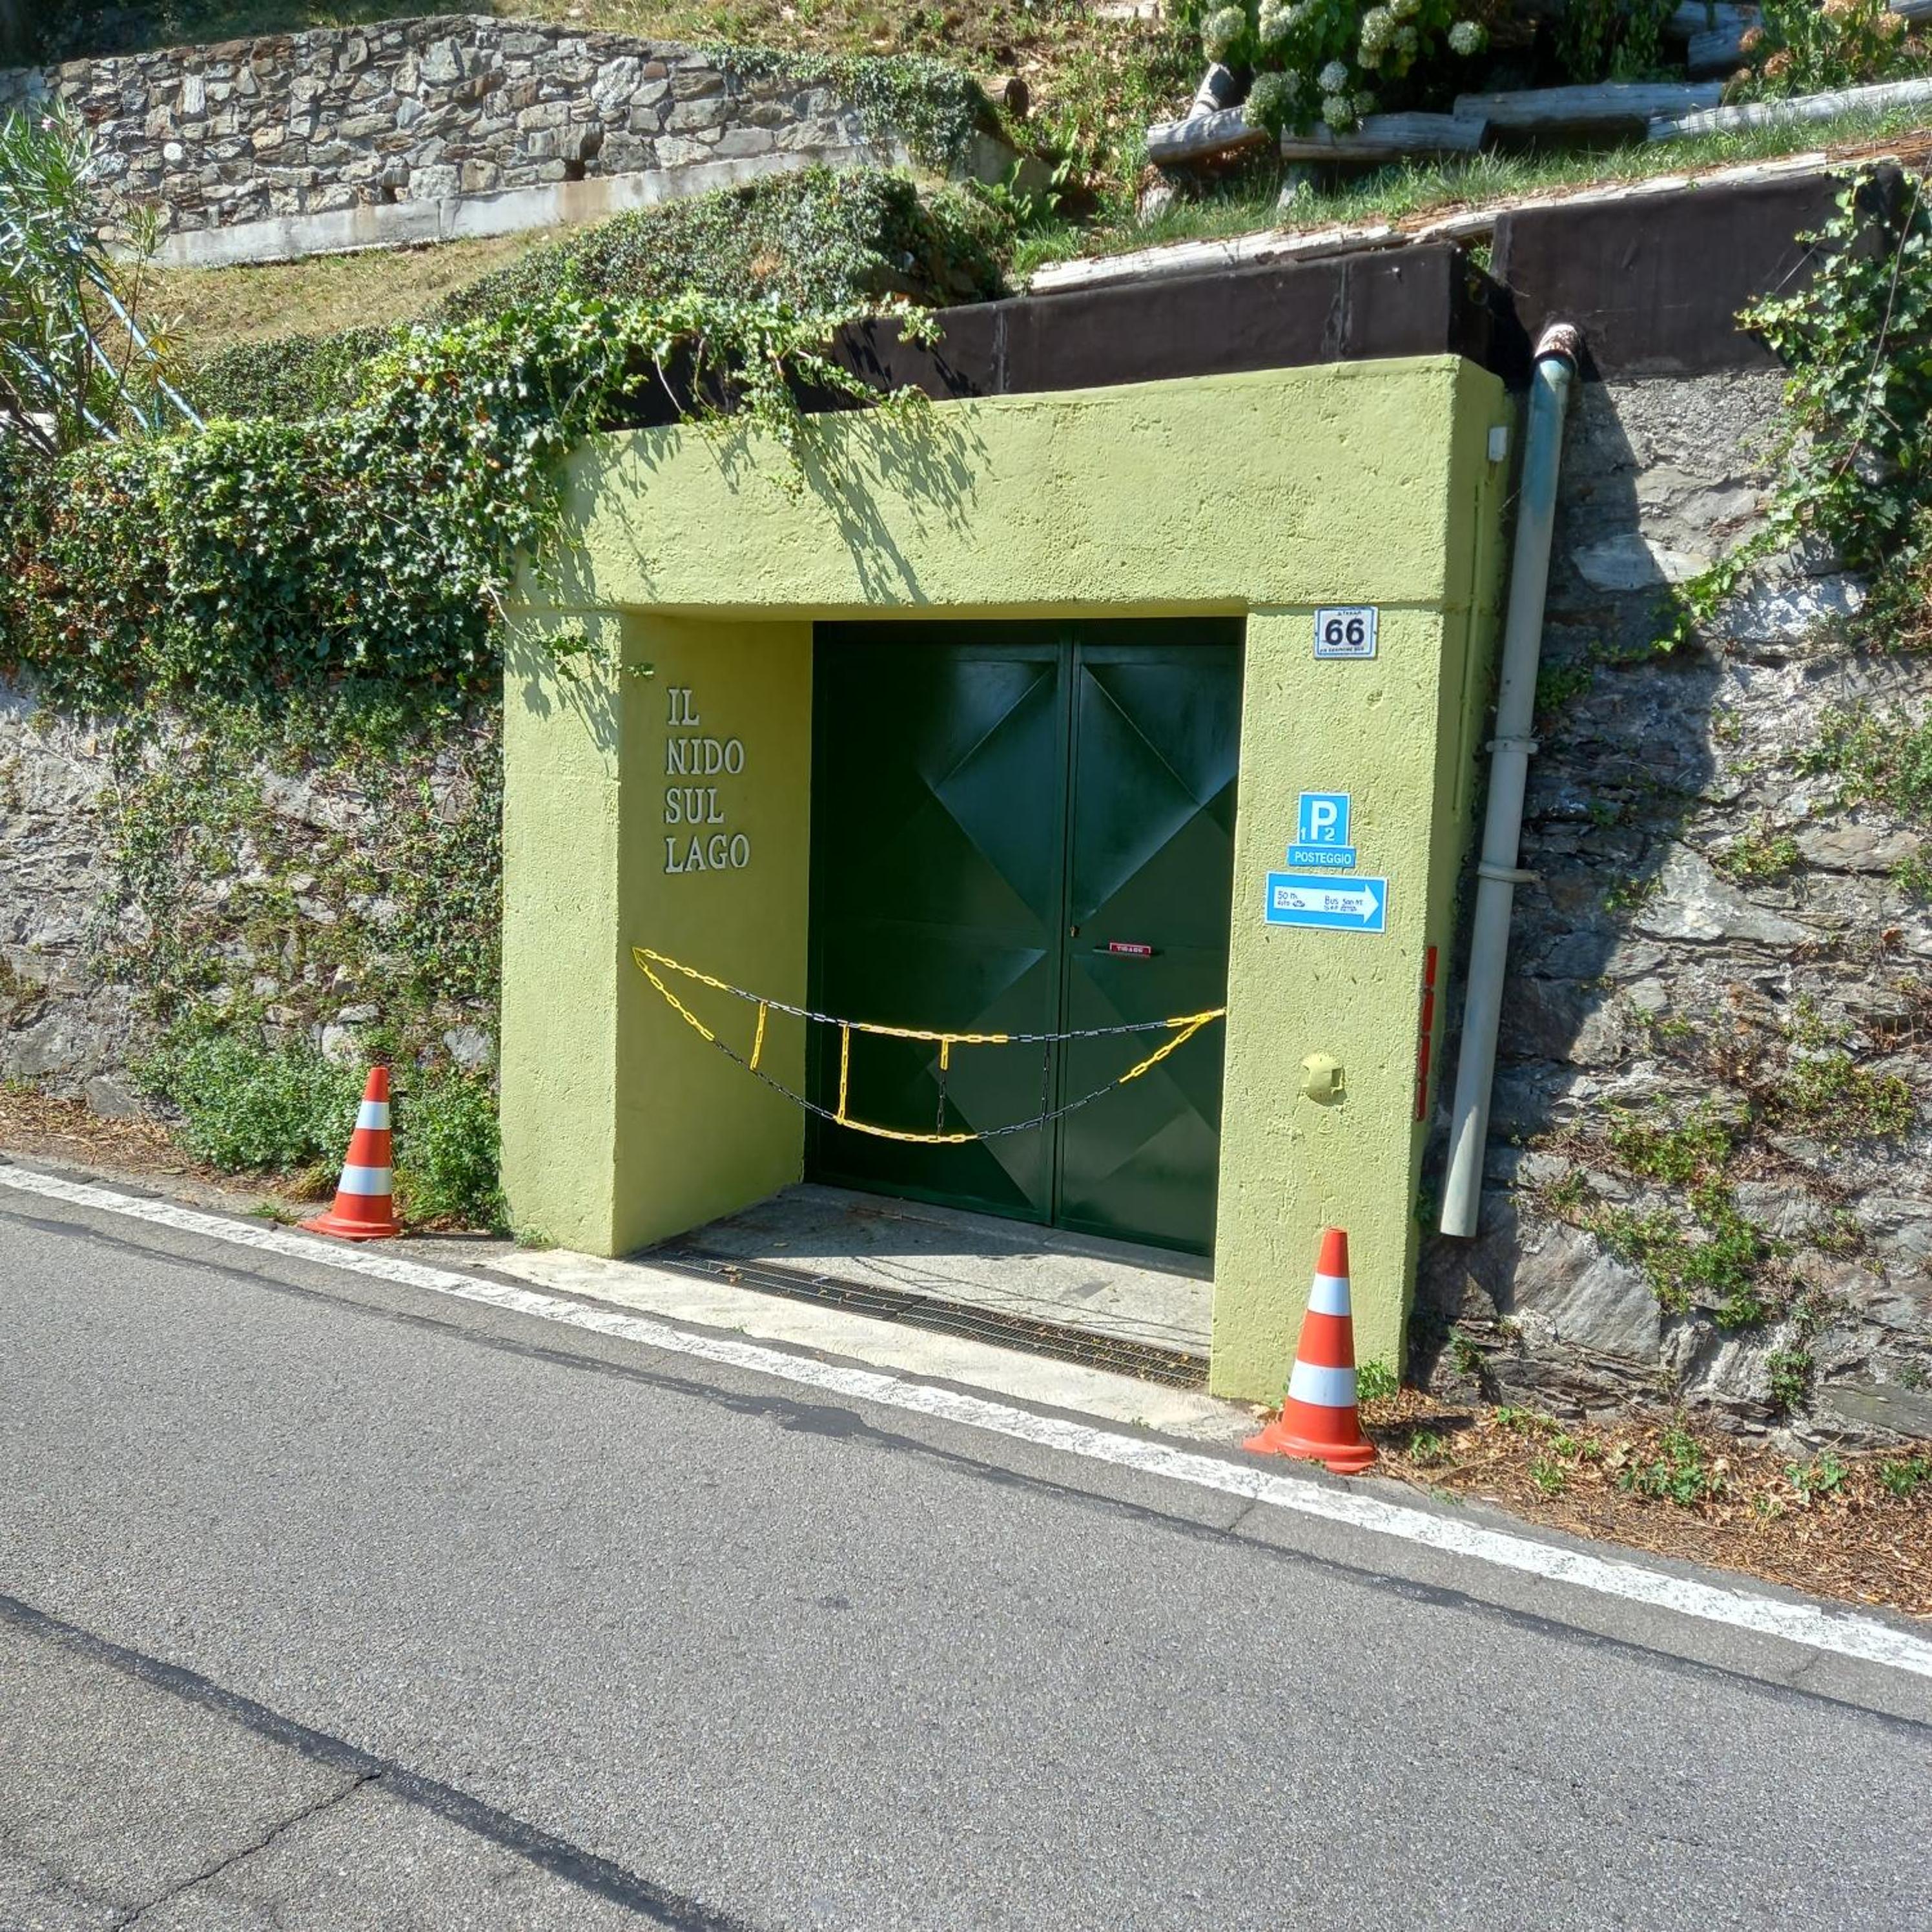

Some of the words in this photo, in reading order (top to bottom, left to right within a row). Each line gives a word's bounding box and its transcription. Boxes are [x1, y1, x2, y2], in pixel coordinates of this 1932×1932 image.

[1325, 618, 1364, 646] 66
[668, 688, 700, 726] IL
[666, 738, 745, 776] NIDO
[665, 787, 724, 825] SUL
[1311, 800, 1338, 840] P
[1325, 827, 1335, 841] 2
[665, 834, 750, 873] LAGO
[1295, 851, 1351, 865] POSTEGGIO
[1277, 890, 1288, 899] 50
[1324, 895, 1339, 905] Bus
